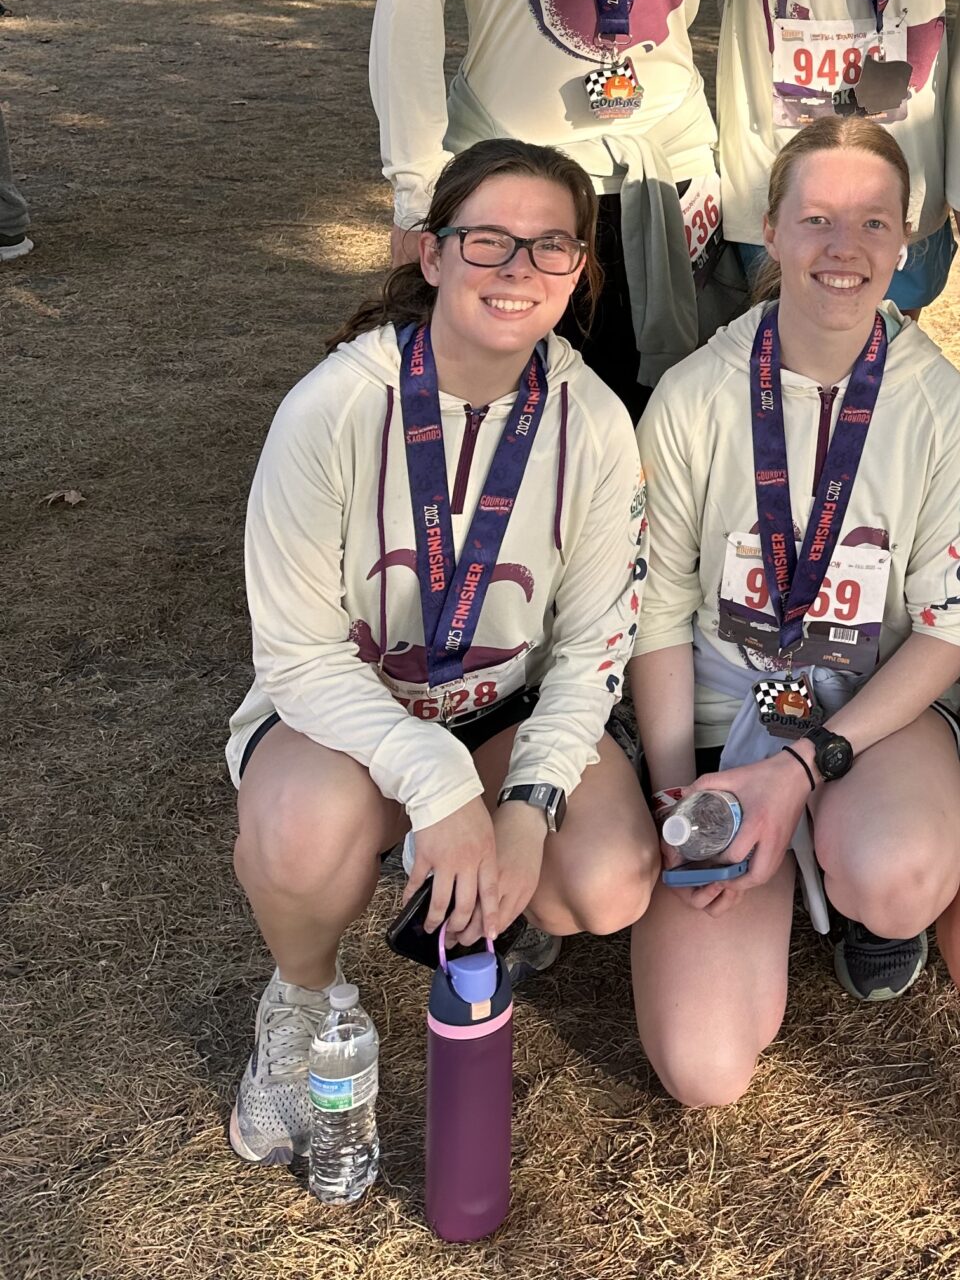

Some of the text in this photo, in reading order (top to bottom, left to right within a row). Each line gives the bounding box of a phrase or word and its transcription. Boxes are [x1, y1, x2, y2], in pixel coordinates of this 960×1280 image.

[832, 92, 851, 105] 5K
[760, 328, 774, 410] 2025 FINISHER
[516, 414, 532, 436] 2025
[756, 470, 787, 481] GOURDY'S
[480, 495, 513, 508] GOURDY'S
[826, 480, 842, 501] 2025
[808, 502, 837, 562] FINISHER
[424, 504, 445, 592] 2025 FINISHER
[771, 532, 790, 592] FINISHER
[452, 562, 484, 629] FINISHER
[445, 630, 463, 651] 2025
